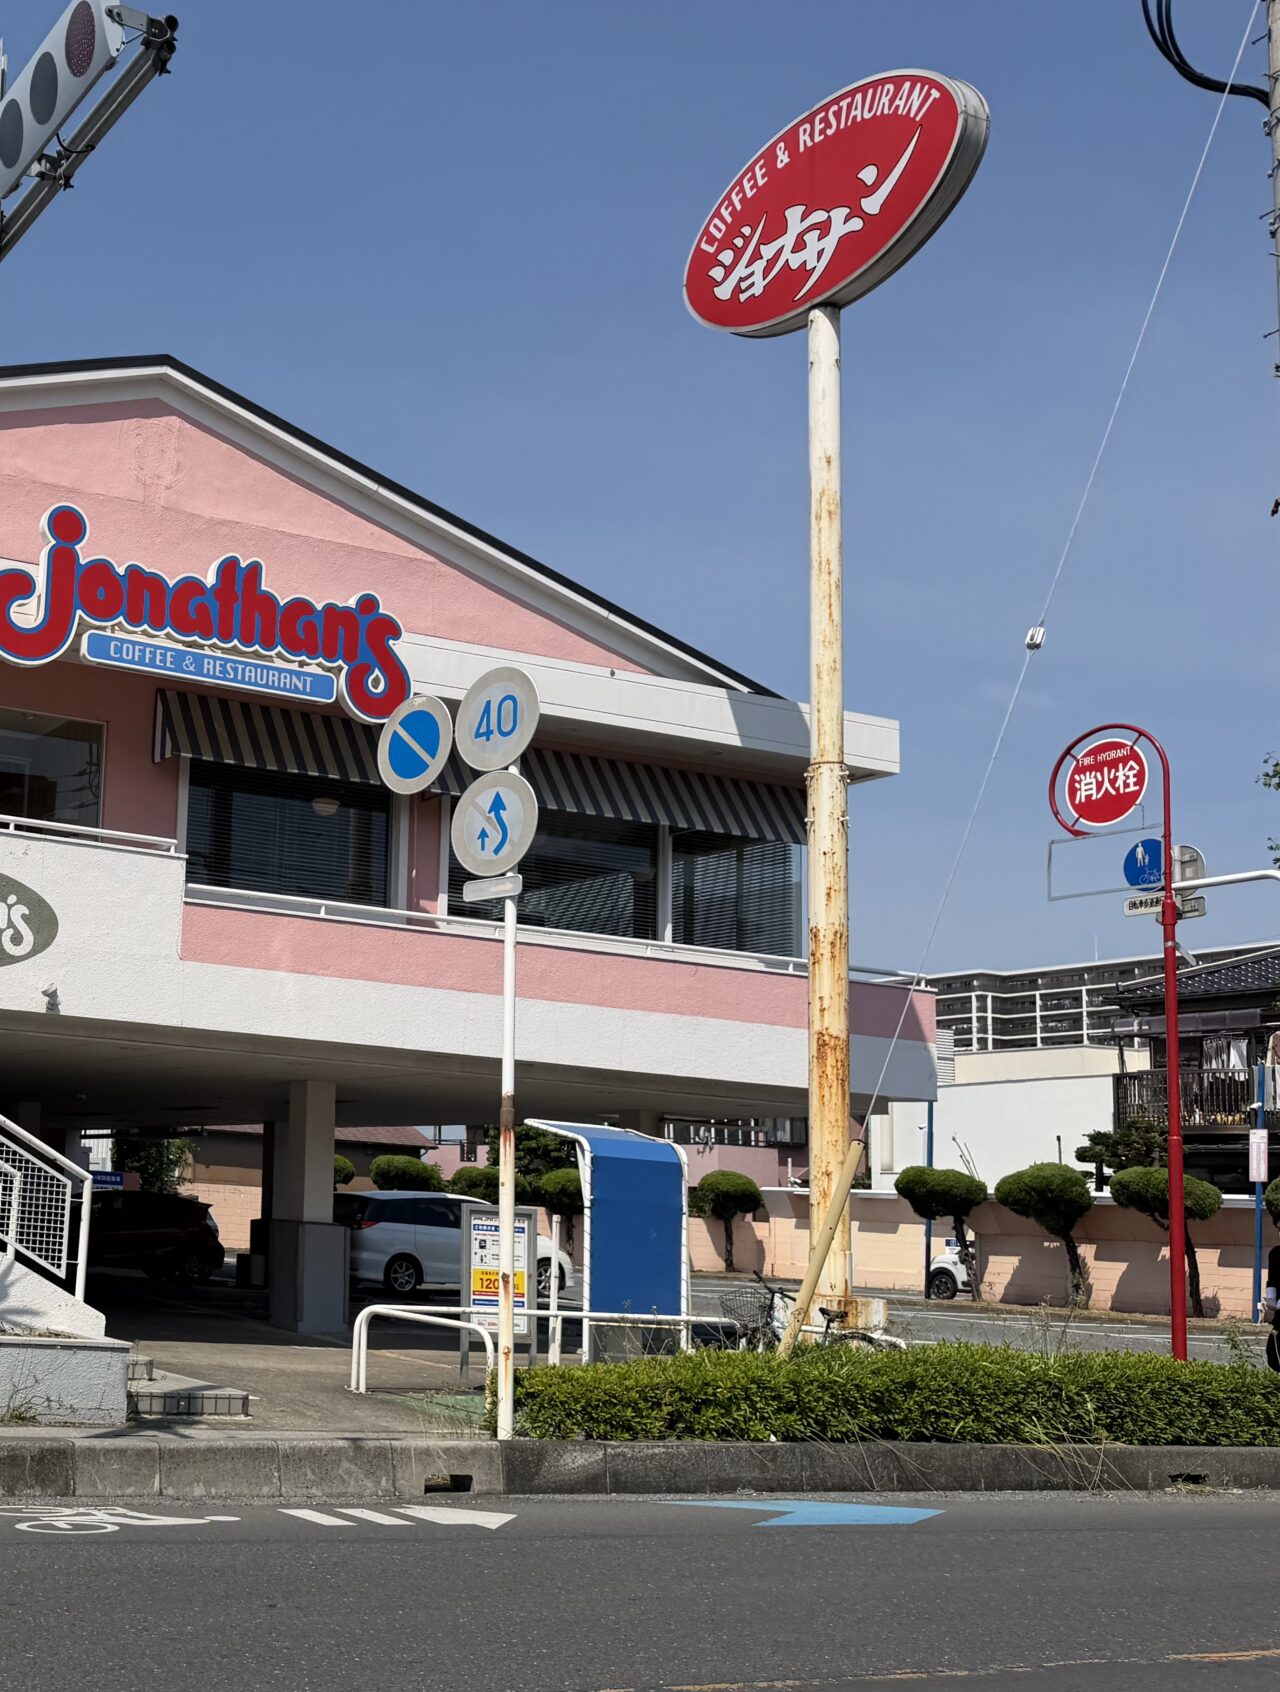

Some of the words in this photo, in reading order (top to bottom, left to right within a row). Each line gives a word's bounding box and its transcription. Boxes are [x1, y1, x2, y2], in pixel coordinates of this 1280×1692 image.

[699, 158, 769, 254] COFFEE
[776, 141, 790, 168] &
[799, 80, 941, 153] RESTAURANT
[707, 124, 922, 303] ジョナサン
[108, 640, 176, 668] COFFEE
[182, 654, 196, 673] &
[203, 659, 314, 693] RESTAURANT
[473, 694, 519, 743] 40
[1074, 759, 1140, 805] 消火栓
[1079, 755, 1095, 767] FIRE
[1097, 746, 1132, 763] HYDRANT
